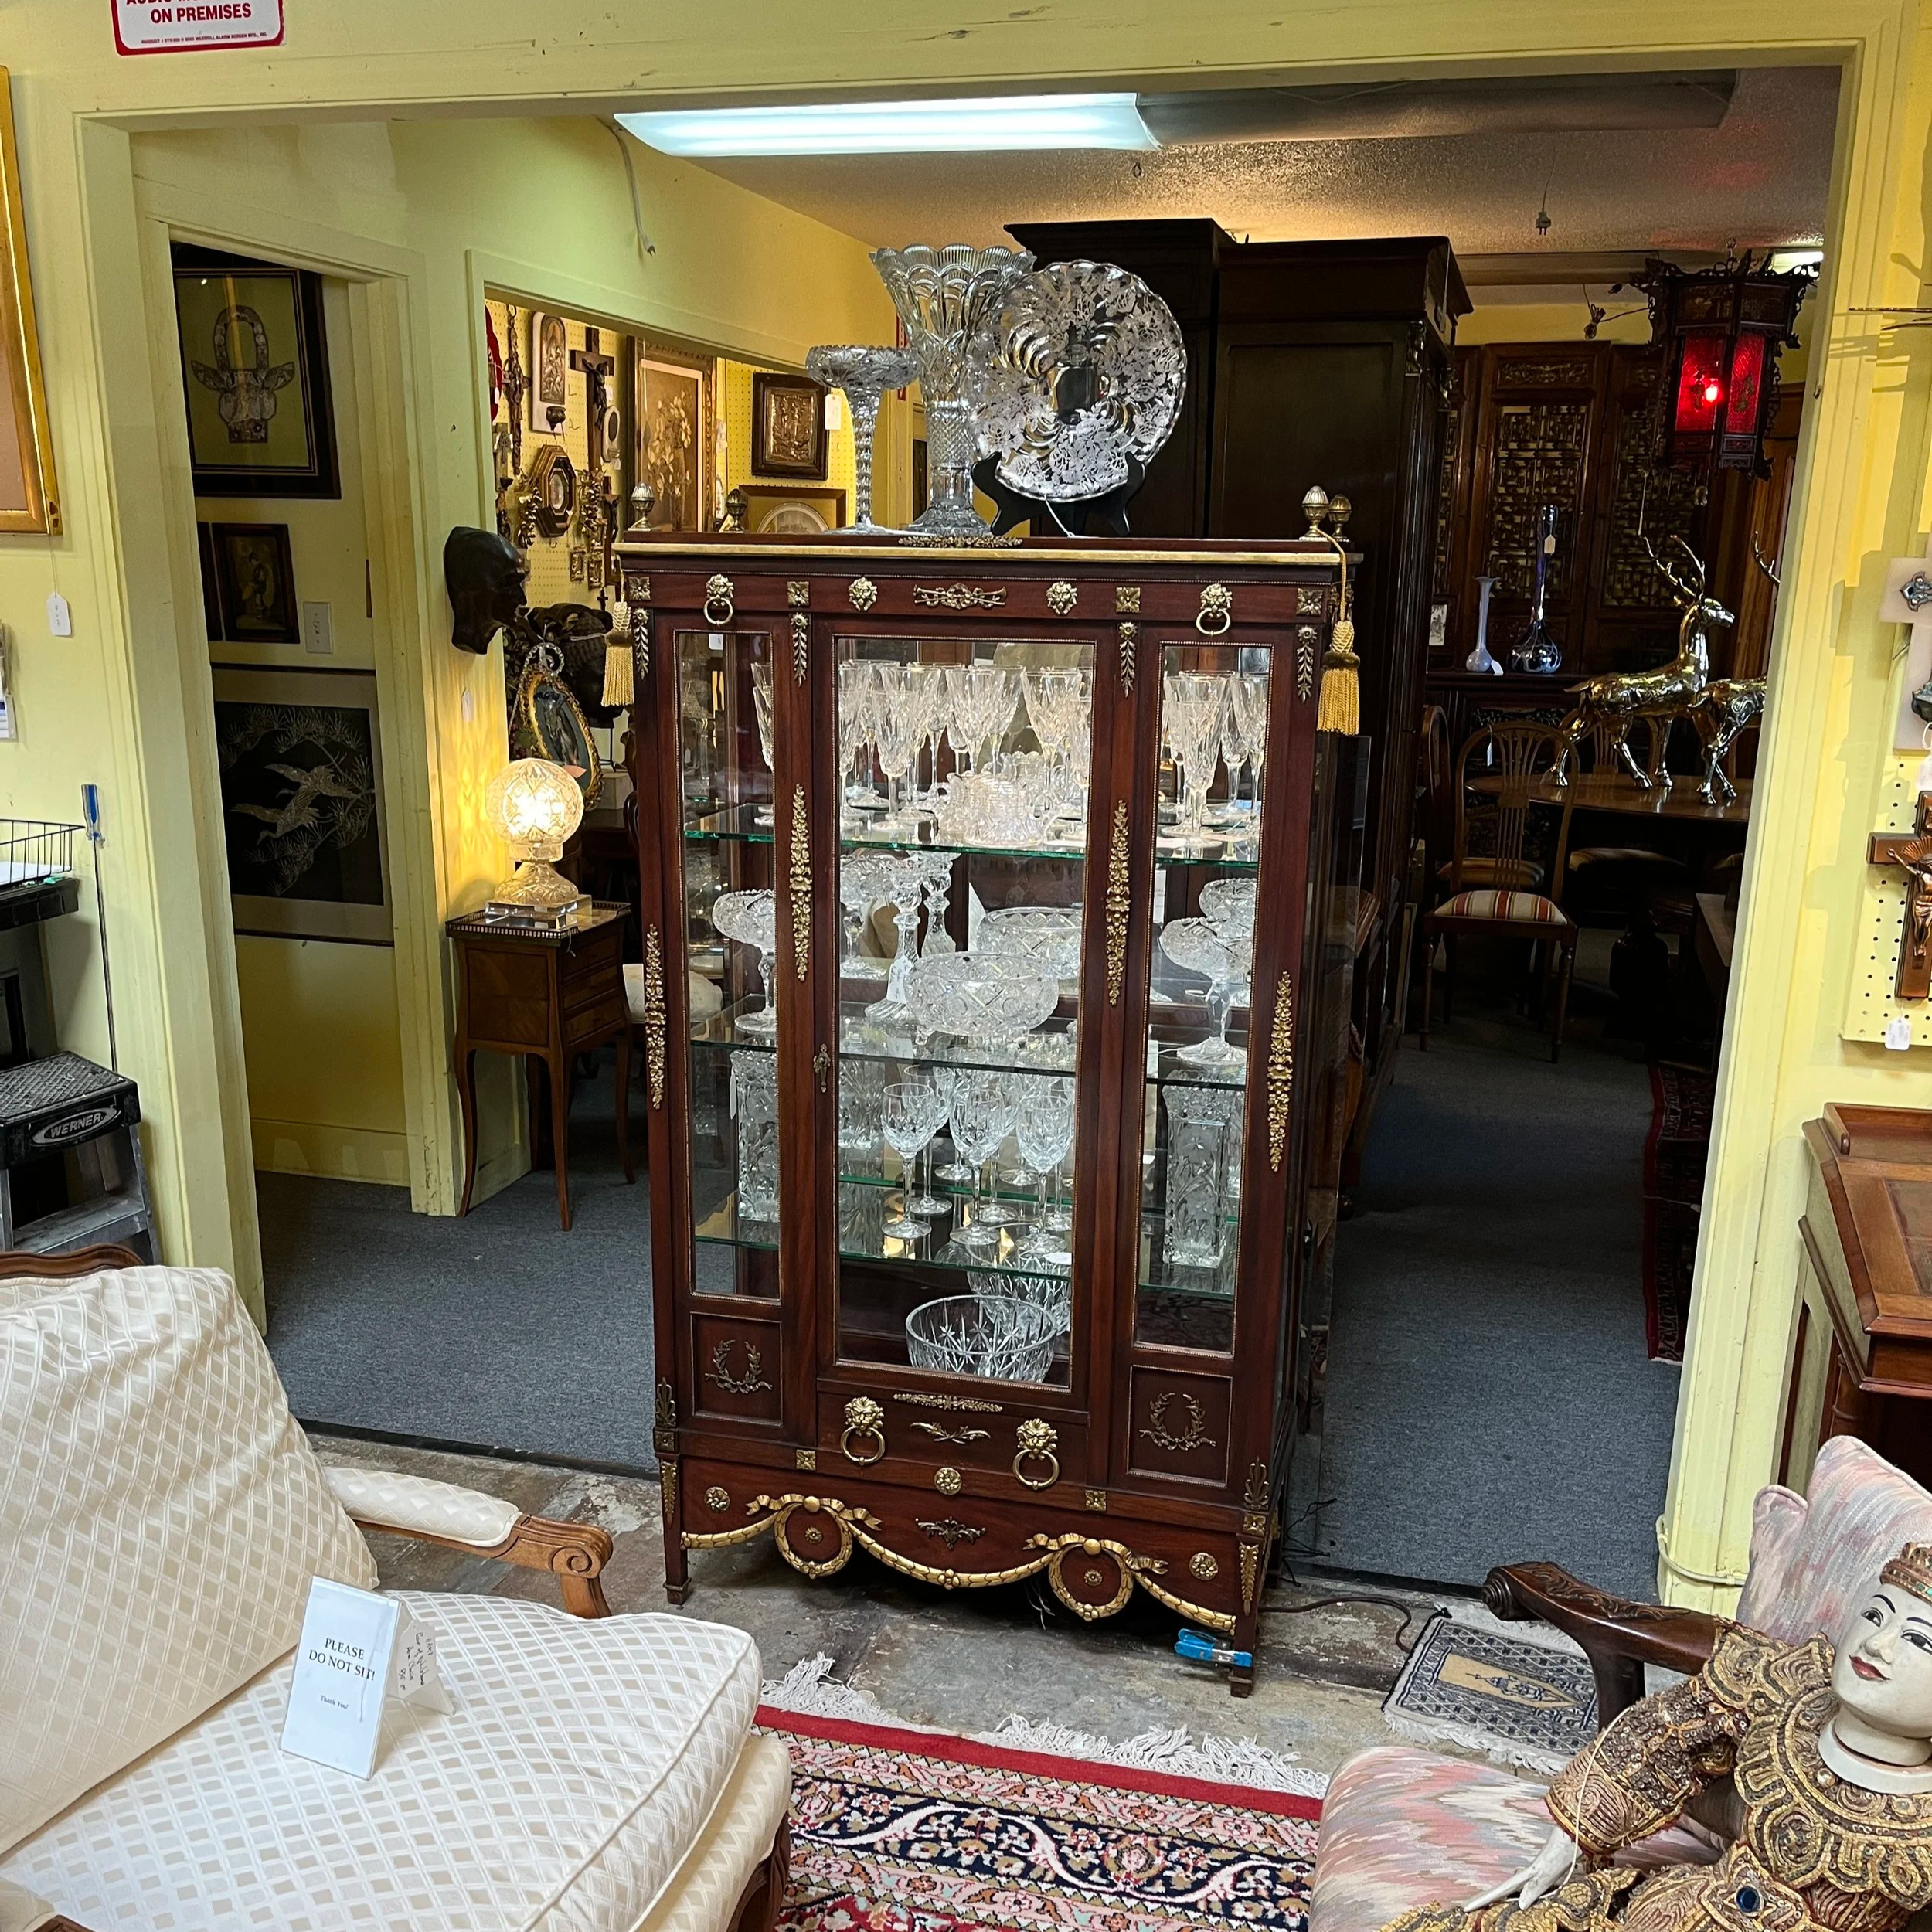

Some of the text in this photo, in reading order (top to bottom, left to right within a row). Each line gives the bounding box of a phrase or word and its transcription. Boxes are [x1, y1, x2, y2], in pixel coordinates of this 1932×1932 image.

[151, 3, 252, 23] ON PREMISES
[51, 1112, 101, 1138] WERNER
[325, 1638, 365, 1660] PLEASE
[309, 1649, 375, 1681] DO NOT SIT!
[321, 1694, 349, 1709] Thank You!
